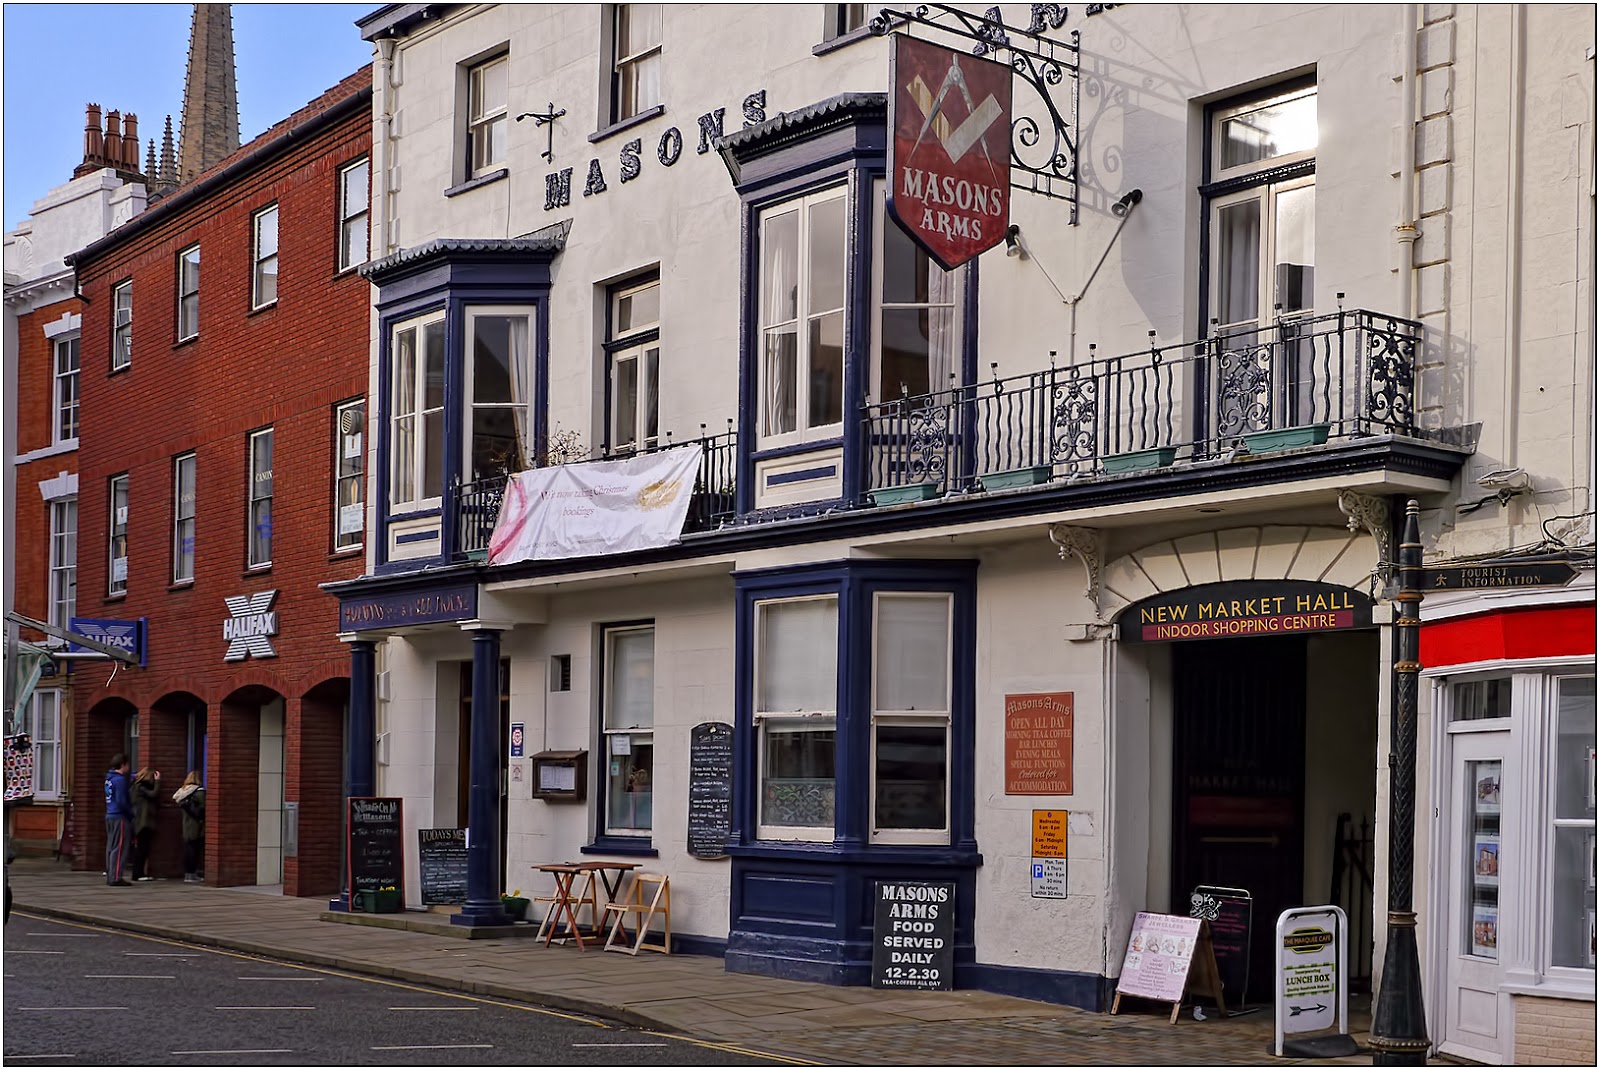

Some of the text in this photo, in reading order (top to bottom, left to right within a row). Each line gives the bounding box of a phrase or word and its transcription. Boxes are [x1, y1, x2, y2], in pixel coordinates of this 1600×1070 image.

[543, 89, 767, 211] MASONS
[901, 166, 1003, 217] MASONS
[919, 208, 982, 242] ARMS
[594, 485, 629, 496] Christmas
[563, 505, 595, 519] bookings
[1461, 567, 1508, 578] TOURIST
[1461, 575, 1541, 588] INFORMATION
[1141, 592, 1355, 624] NEW MARKET HALL
[223, 611, 275, 640] HALIFAX
[1157, 613, 1336, 639] INDOOR SHOPPING CENTRE
[1007, 696, 1070, 717] Masons Arms
[1011, 716, 1065, 729] OPEN ALL DAY
[1006, 730, 1031, 739] MORNING
[1050, 729, 1072, 738] COFFEE
[1019, 740, 1058, 749] BAR LUNCHES
[1015, 749, 1061, 759] EVENING MEALS
[1011, 759, 1066, 768] SPECIAL FUNCTIONS
[1009, 781, 1067, 791] ACCOMMODATION
[882, 885, 948, 902] MASONS
[889, 903, 938, 919] ARMS
[893, 921, 934, 933] FOOD
[1148, 921, 1184, 930] JEWELLERS
[884, 936, 944, 949] SERVED
[892, 952, 934, 964] DAILY
[885, 967, 939, 980] 12-2.30
[1286, 974, 1331, 985] LUNCH BOX
